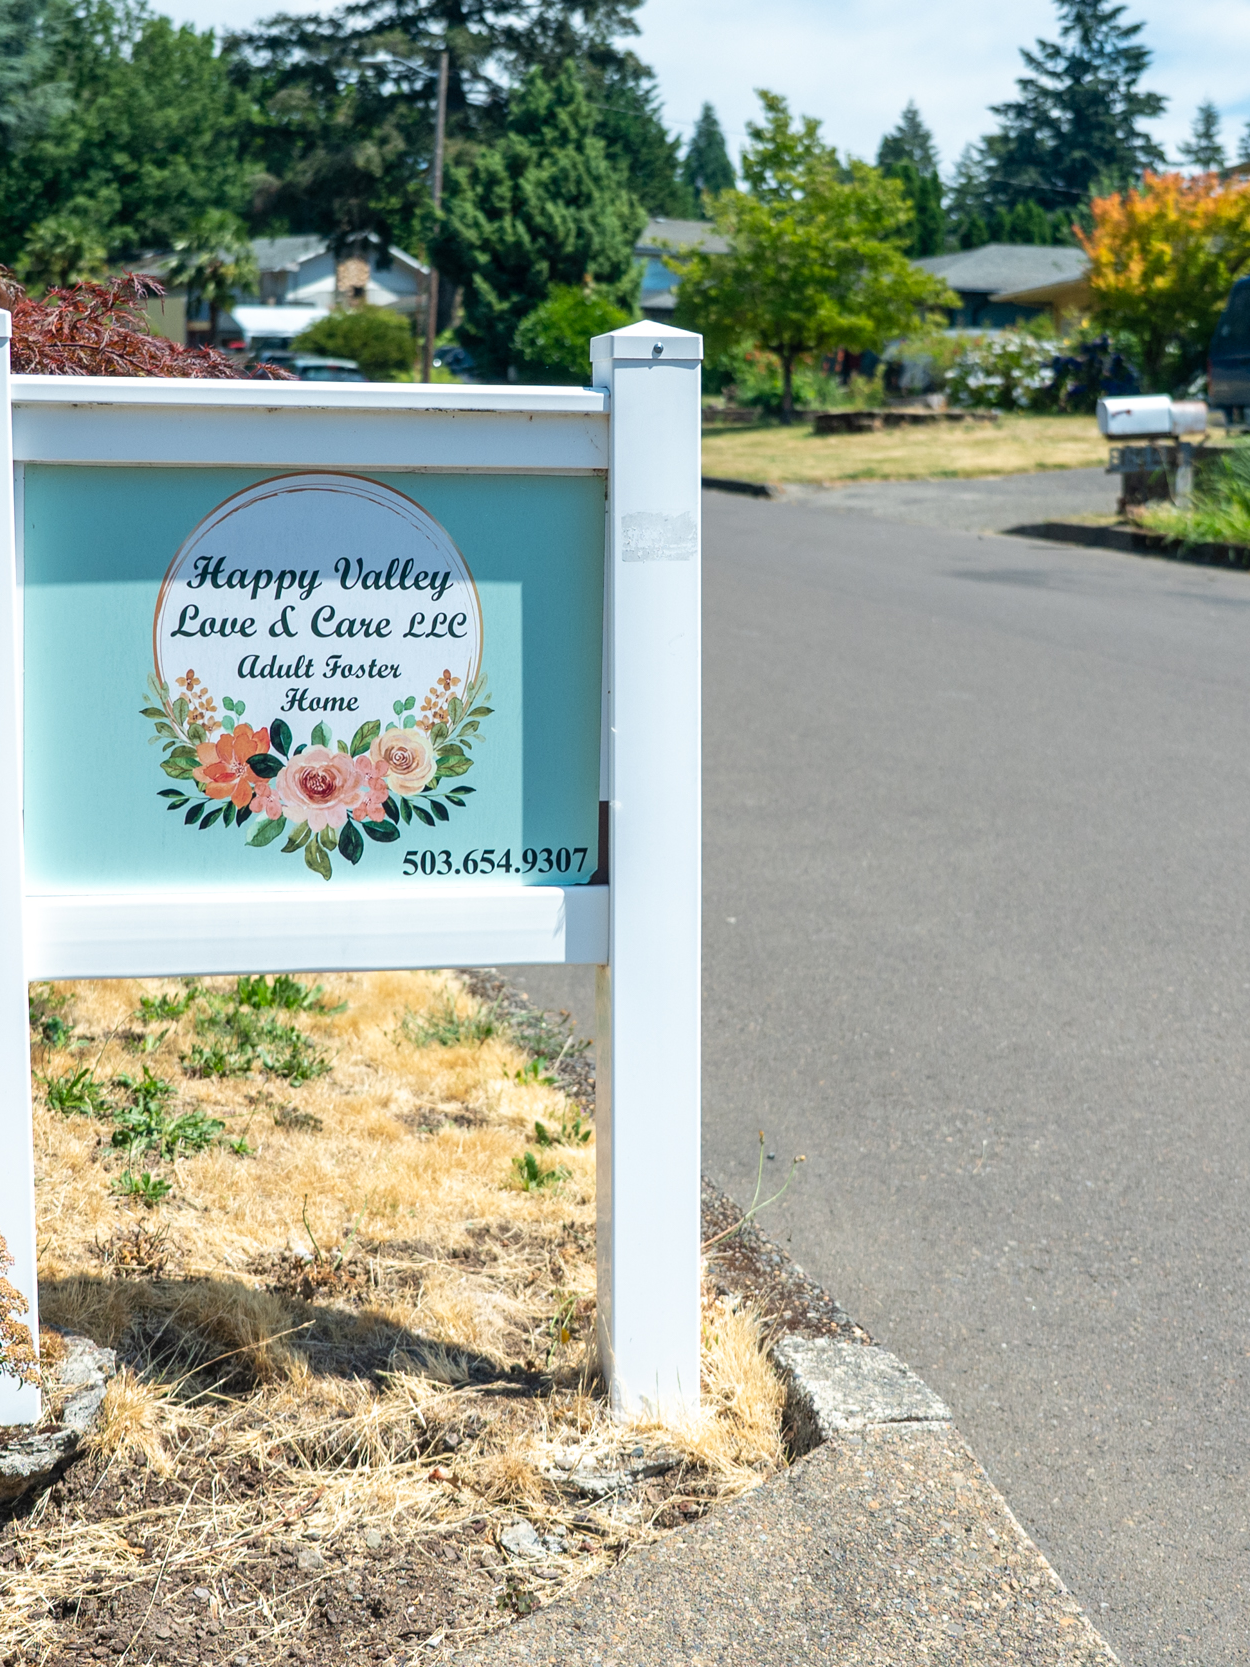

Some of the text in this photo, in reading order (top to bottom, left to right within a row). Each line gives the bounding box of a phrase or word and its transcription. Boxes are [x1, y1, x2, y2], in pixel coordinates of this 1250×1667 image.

[186, 555, 454, 602] Happy Valley
[170, 604, 468, 639] Love & Care LLC
[237, 654, 402, 679] Adult Foster
[280, 687, 360, 712] Home
[402, 847, 590, 876] 503.654.9307
